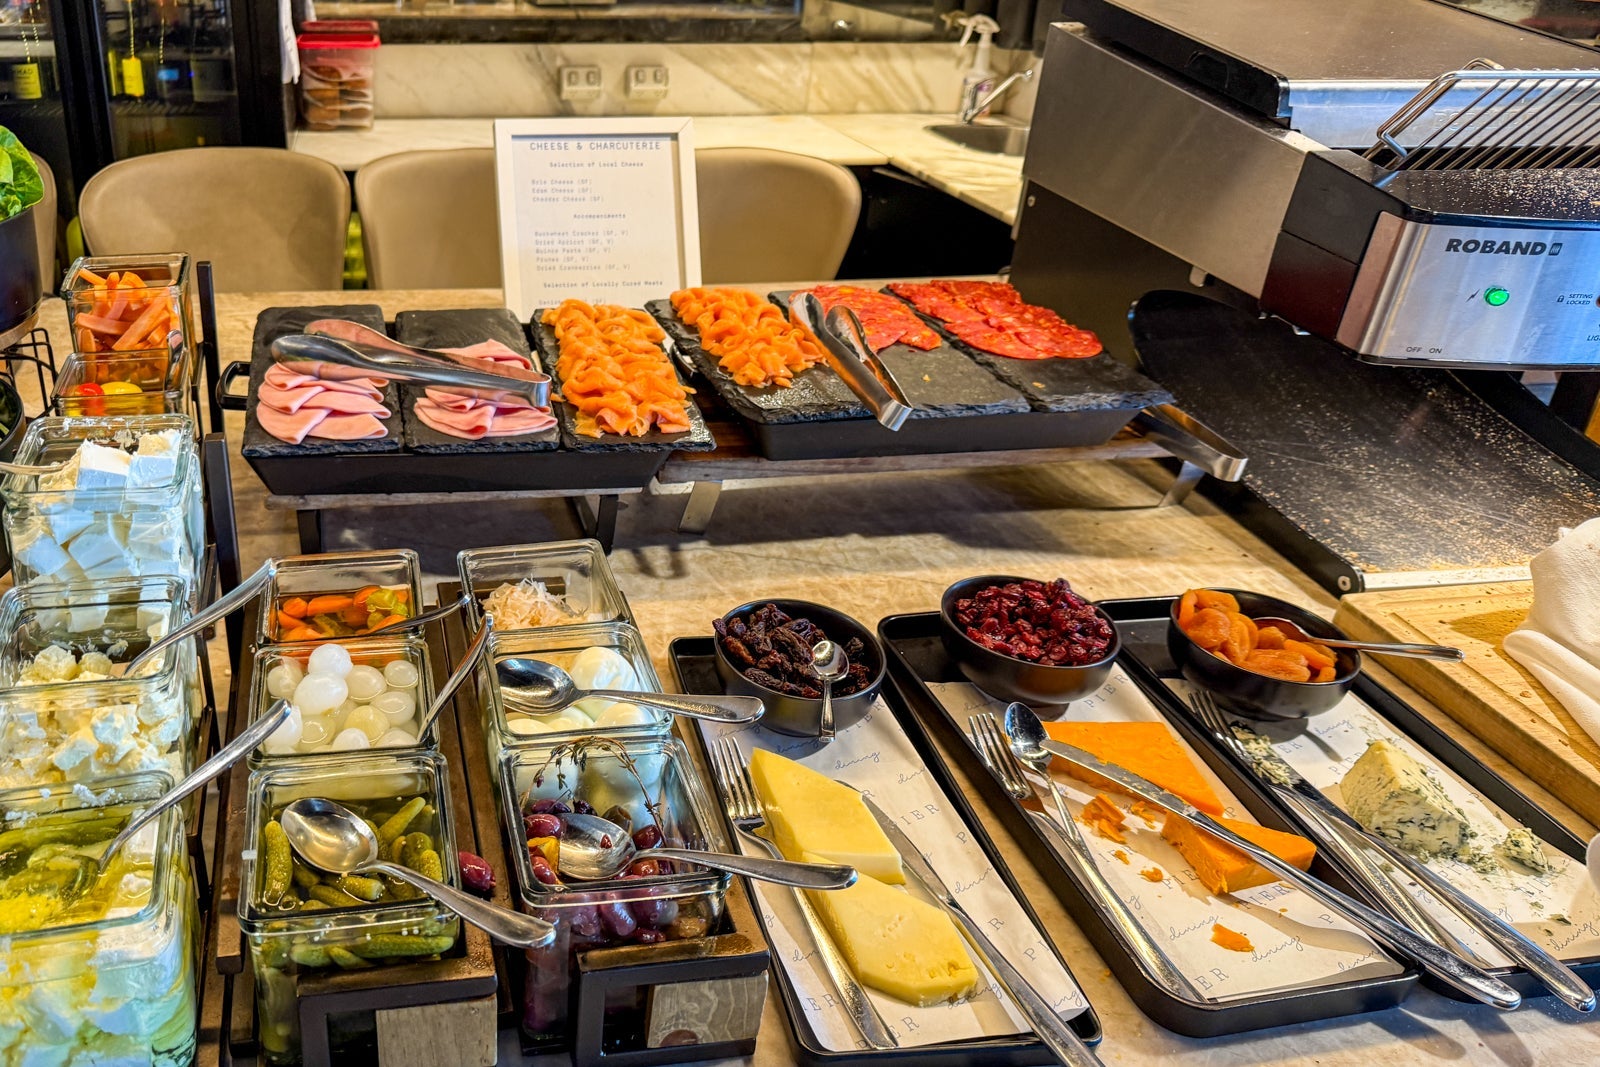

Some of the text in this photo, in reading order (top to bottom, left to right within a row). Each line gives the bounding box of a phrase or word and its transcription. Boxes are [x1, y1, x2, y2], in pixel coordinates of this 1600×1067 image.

[529, 142, 661, 151] CHEESE & CHARCUTERIE
[1444, 238, 1547, 256] ROBAND
[1587, 334, 1600, 342] LIG
[1083, 674, 1129, 709] PIER
[834, 751, 881, 770] dining
[900, 803, 940, 826] IER
[954, 866, 993, 894] dinin
[1160, 869, 1200, 890] PIE
[1168, 915, 1220, 942] dining
[1552, 921, 1600, 951] dining
[1251, 934, 1304, 964] dining
[1194, 967, 1230, 991] ER
